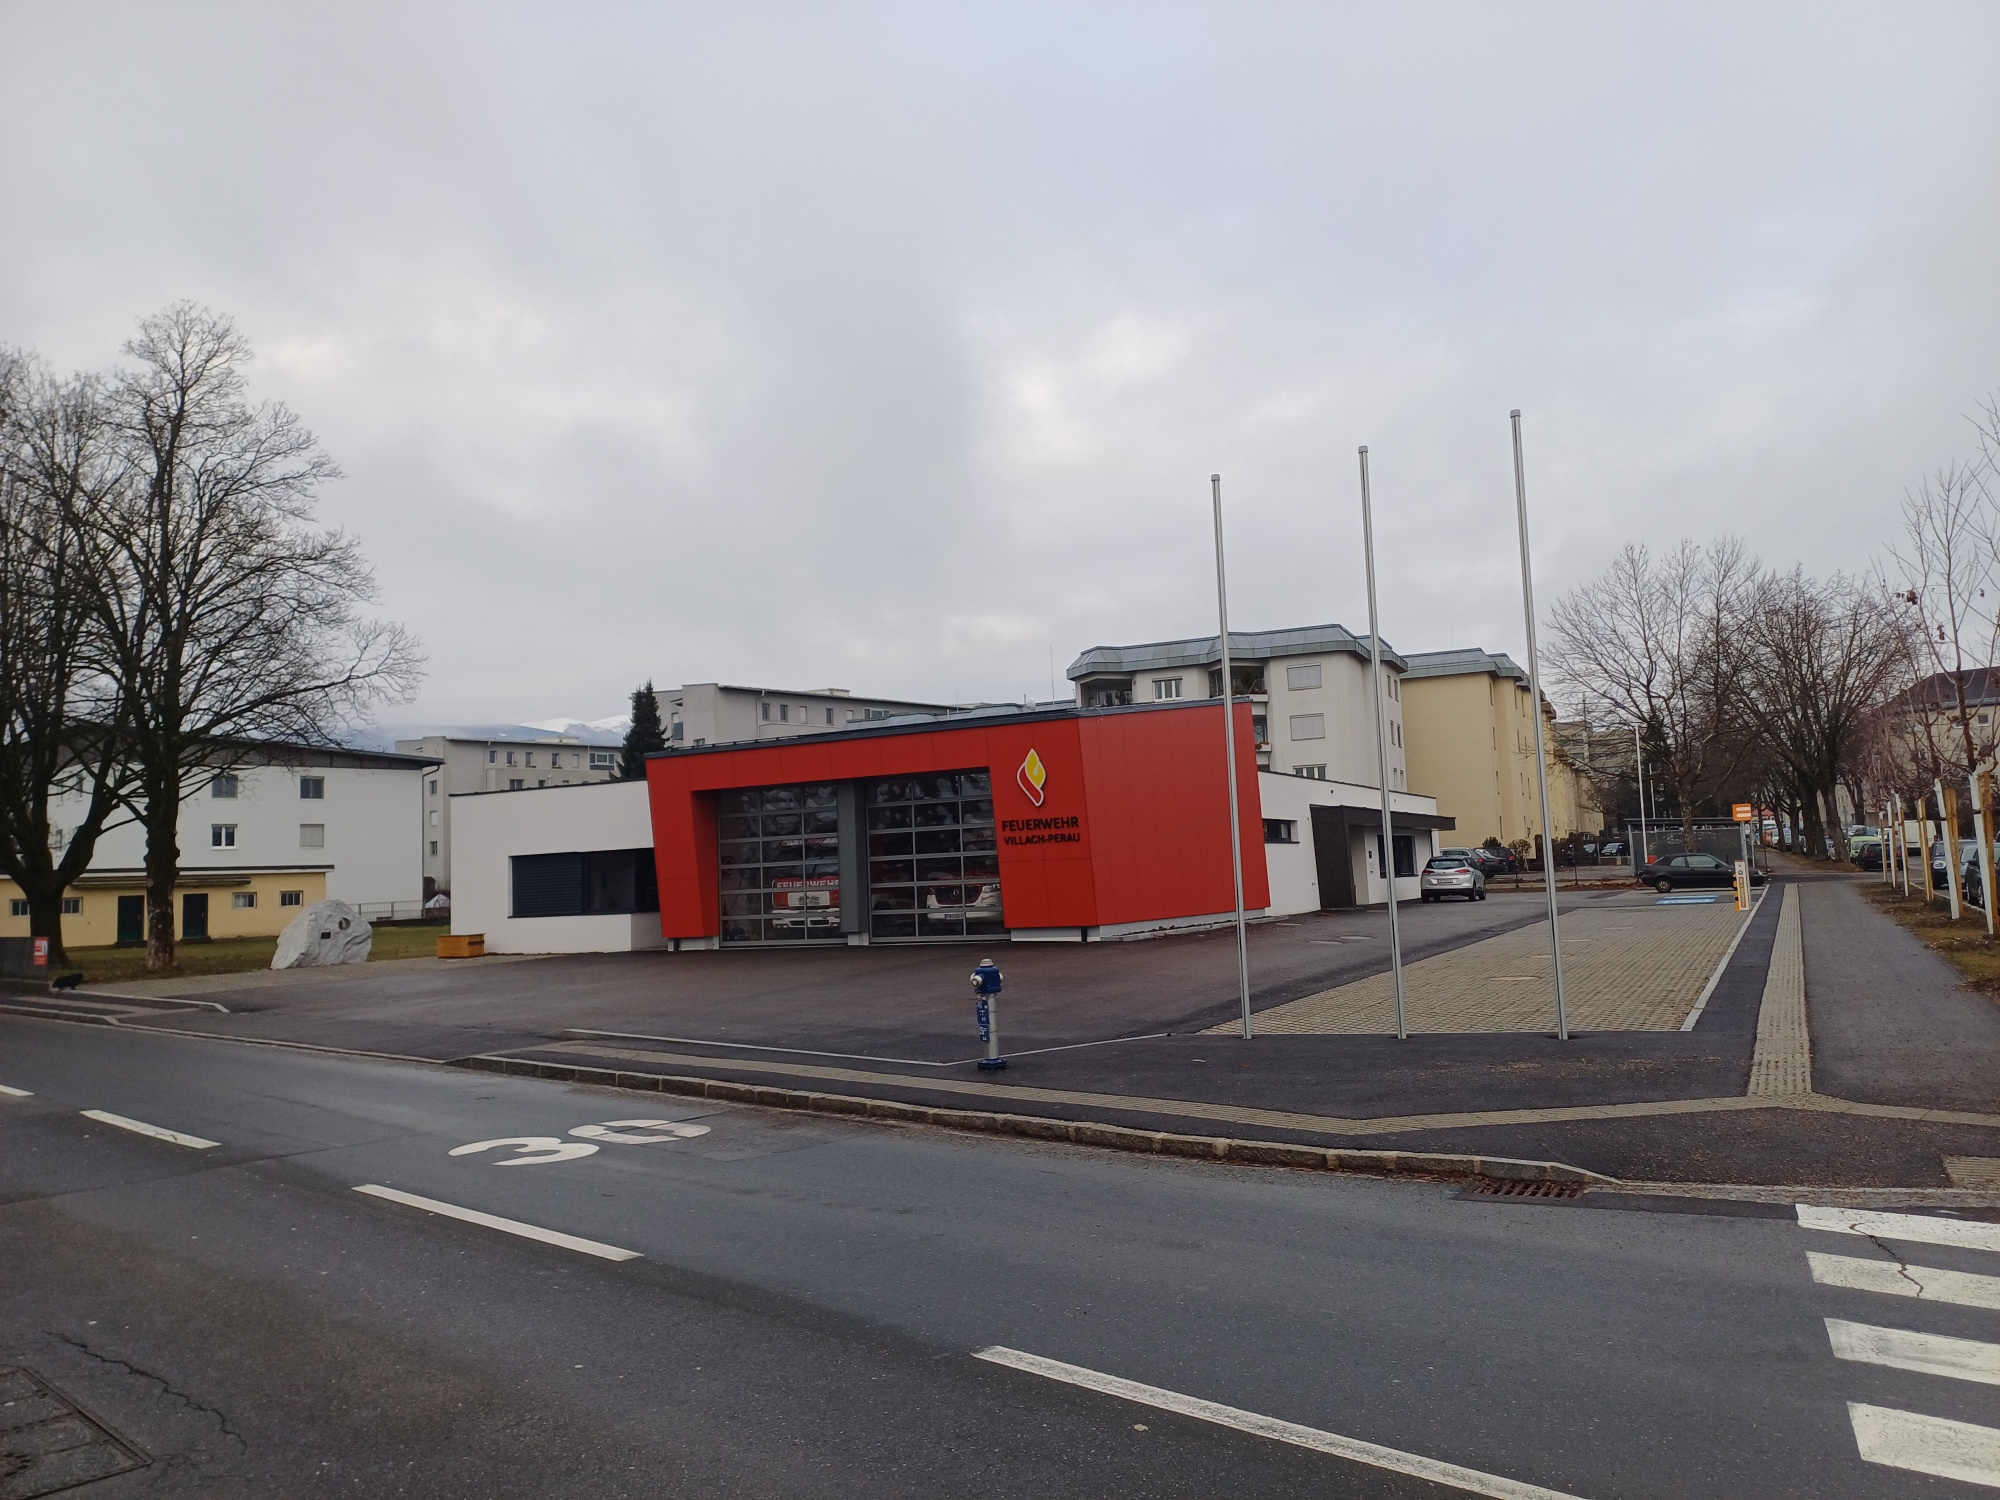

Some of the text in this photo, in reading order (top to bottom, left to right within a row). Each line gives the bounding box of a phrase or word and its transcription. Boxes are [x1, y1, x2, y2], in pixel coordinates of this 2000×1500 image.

[1001, 816, 1079, 831] FEUERWEHR
[1003, 833, 1080, 845] VILLACH-PERAU
[448, 1119, 711, 1166] 30
